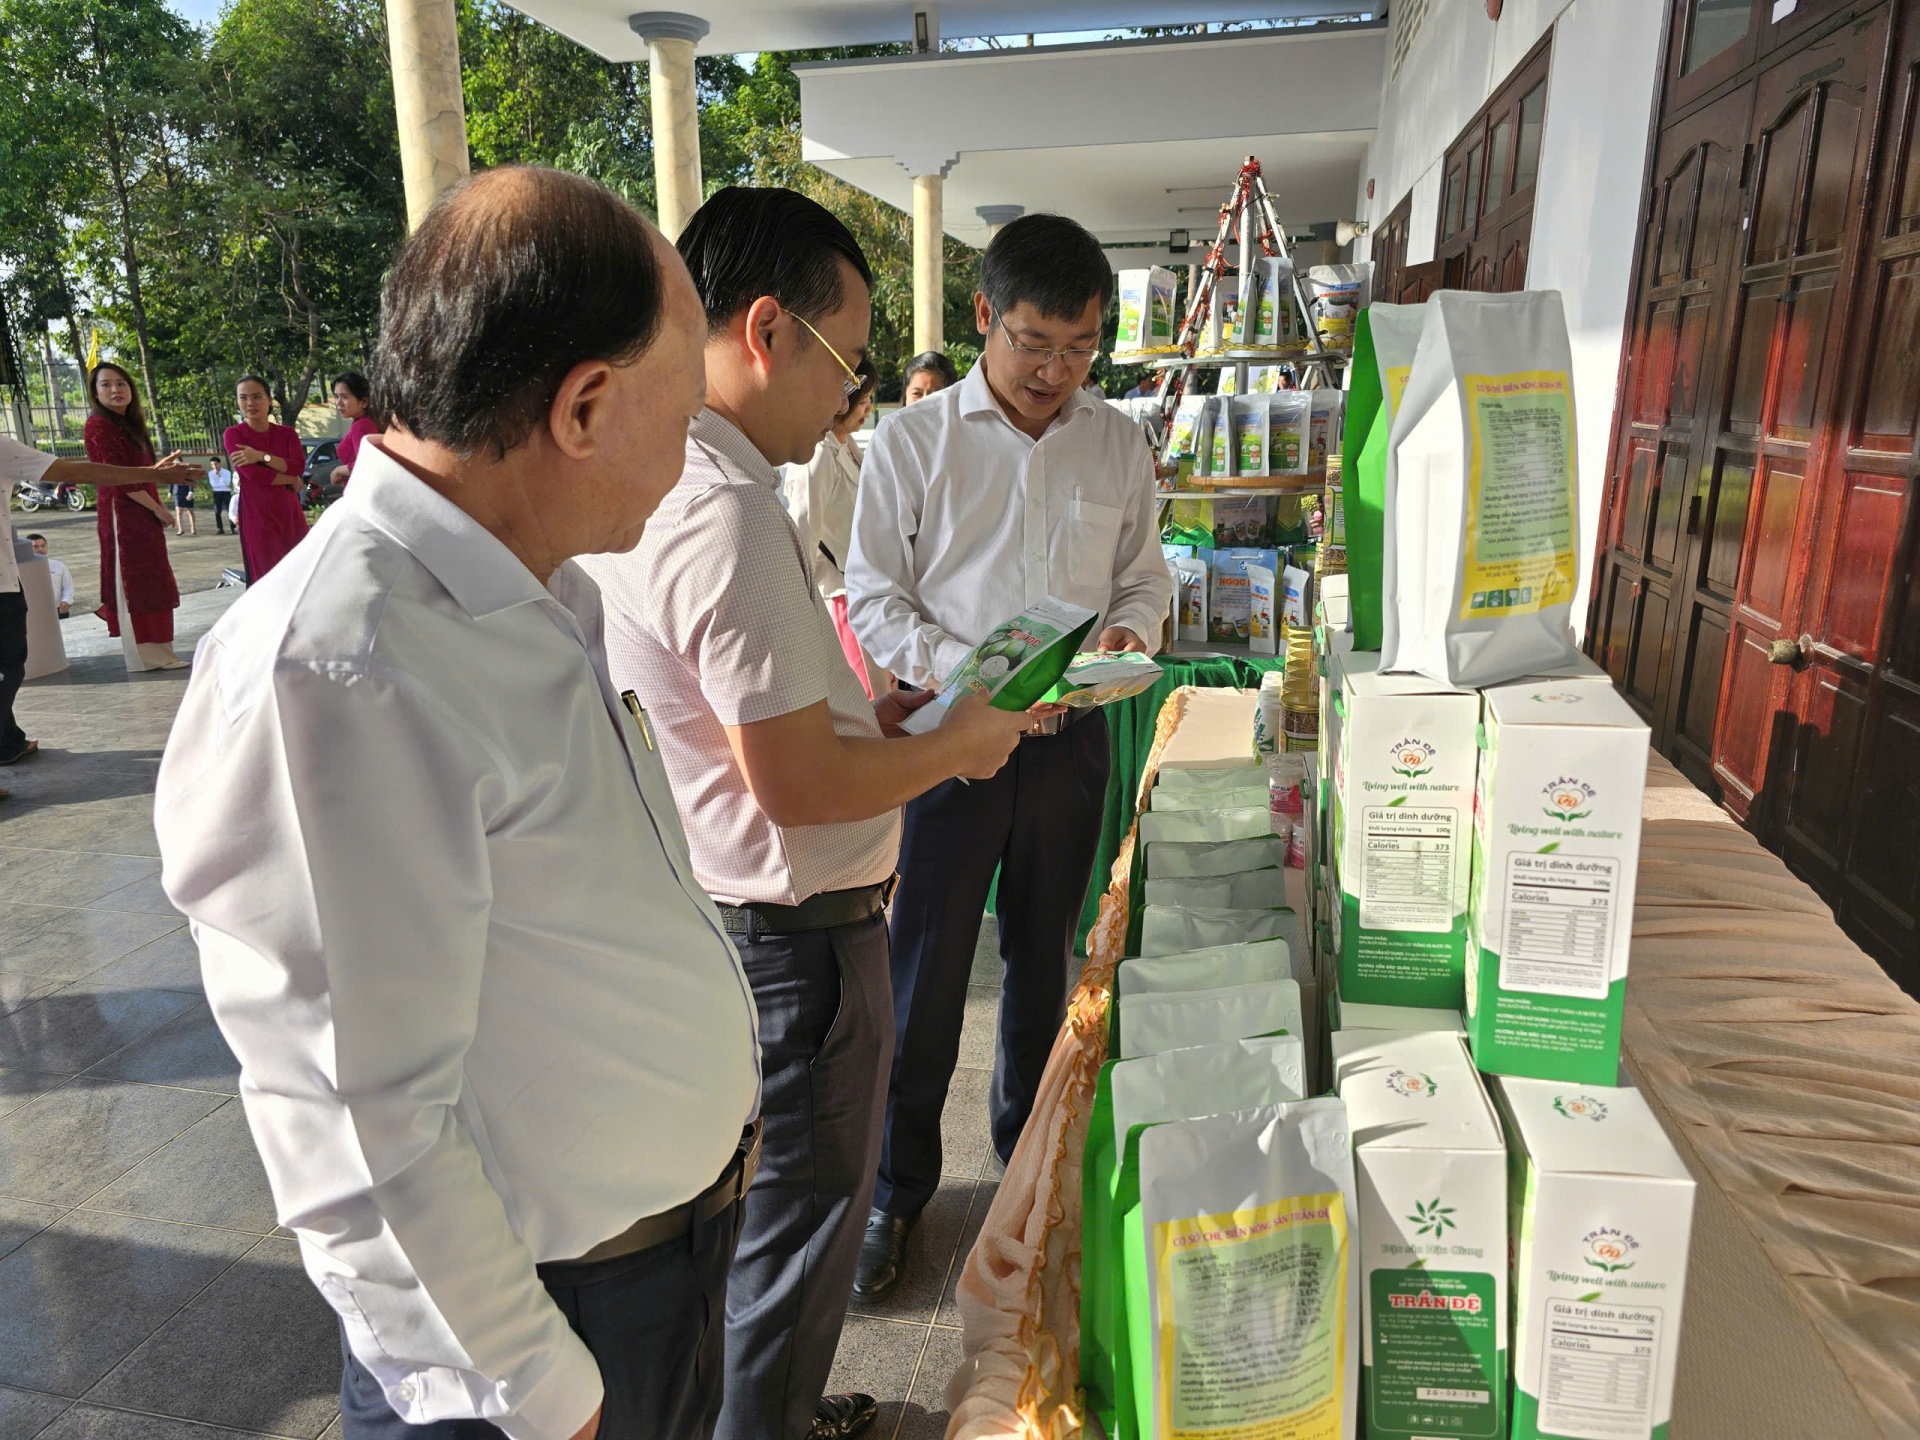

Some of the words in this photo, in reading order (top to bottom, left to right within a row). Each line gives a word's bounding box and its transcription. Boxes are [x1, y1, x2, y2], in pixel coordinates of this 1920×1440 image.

[1362, 781, 1389, 792] Living
[1390, 782, 1408, 791] well
[1409, 782, 1428, 791] with
[1429, 784, 1460, 792] nature
[1368, 811, 1384, 820] Giá
[1386, 812, 1396, 821] trị
[1398, 811, 1419, 821] dinh
[1421, 812, 1452, 822] dưỡng
[1540, 826, 1561, 836] well
[1562, 827, 1585, 837] with
[1587, 829, 1623, 839] nature
[1367, 841, 1400, 850] Calories
[1434, 843, 1450, 851] 373
[1514, 858, 1531, 867] Giá
[1549, 861, 1573, 870] dinh
[1511, 892, 1550, 902] Calories
[1203, 1228, 1222, 1241] CHẾ
[1225, 1225, 1247, 1239] BIẾN
[1581, 1274, 1603, 1286] well
[1604, 1276, 1628, 1288] with
[1389, 1290, 1448, 1309] TRẦN
[1450, 1293, 1482, 1314] ĐỆ
[1553, 1305, 1571, 1314] Giá
[1590, 1308, 1615, 1318] dinh
[1551, 1337, 1591, 1349] Calories
